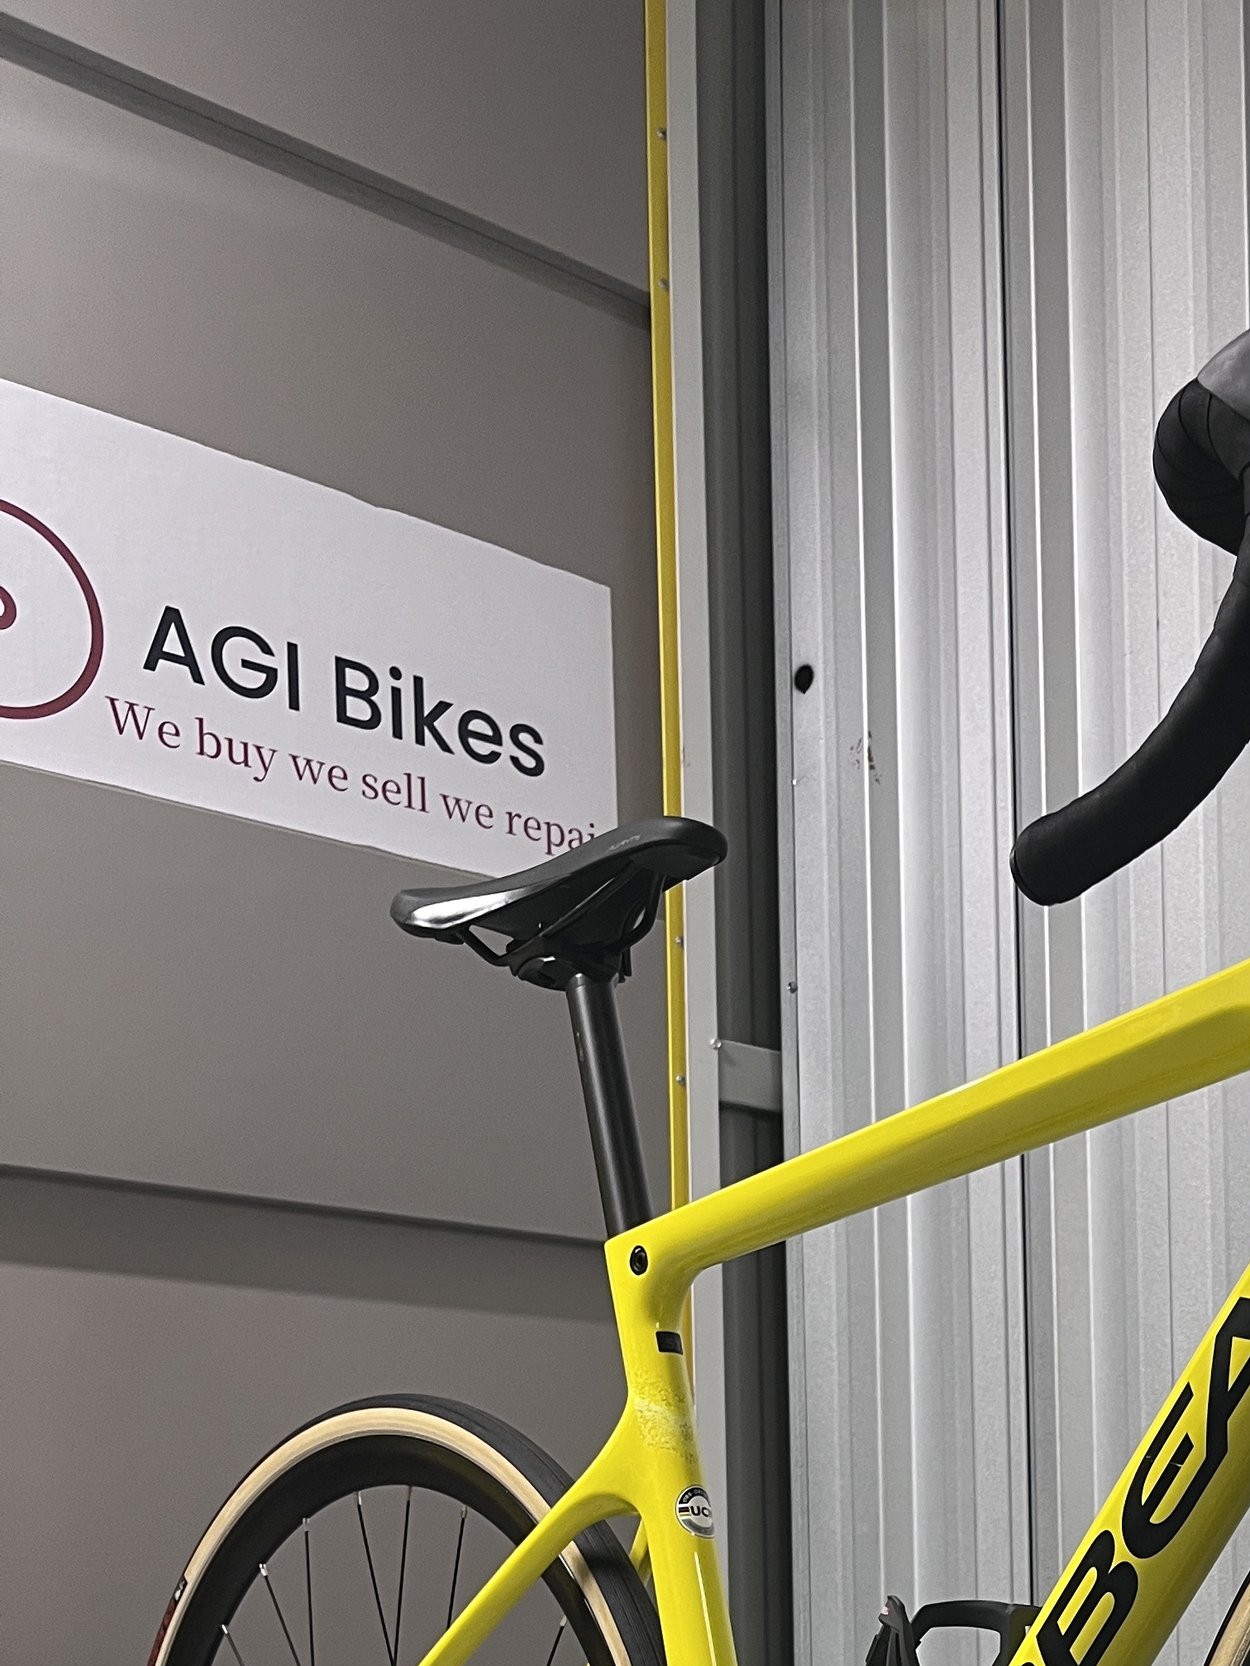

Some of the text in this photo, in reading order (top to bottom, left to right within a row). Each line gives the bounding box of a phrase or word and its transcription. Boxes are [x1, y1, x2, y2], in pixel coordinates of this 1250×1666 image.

[143, 605, 545, 778] AGI Bikes
[105, 695, 181, 748] We
[195, 717, 278, 782] buy
[288, 753, 349, 791] we
[361, 772, 428, 813] sell
[439, 793, 494, 829] we
[505, 811, 597, 857] repai
[690, 1505, 713, 1519] UC
